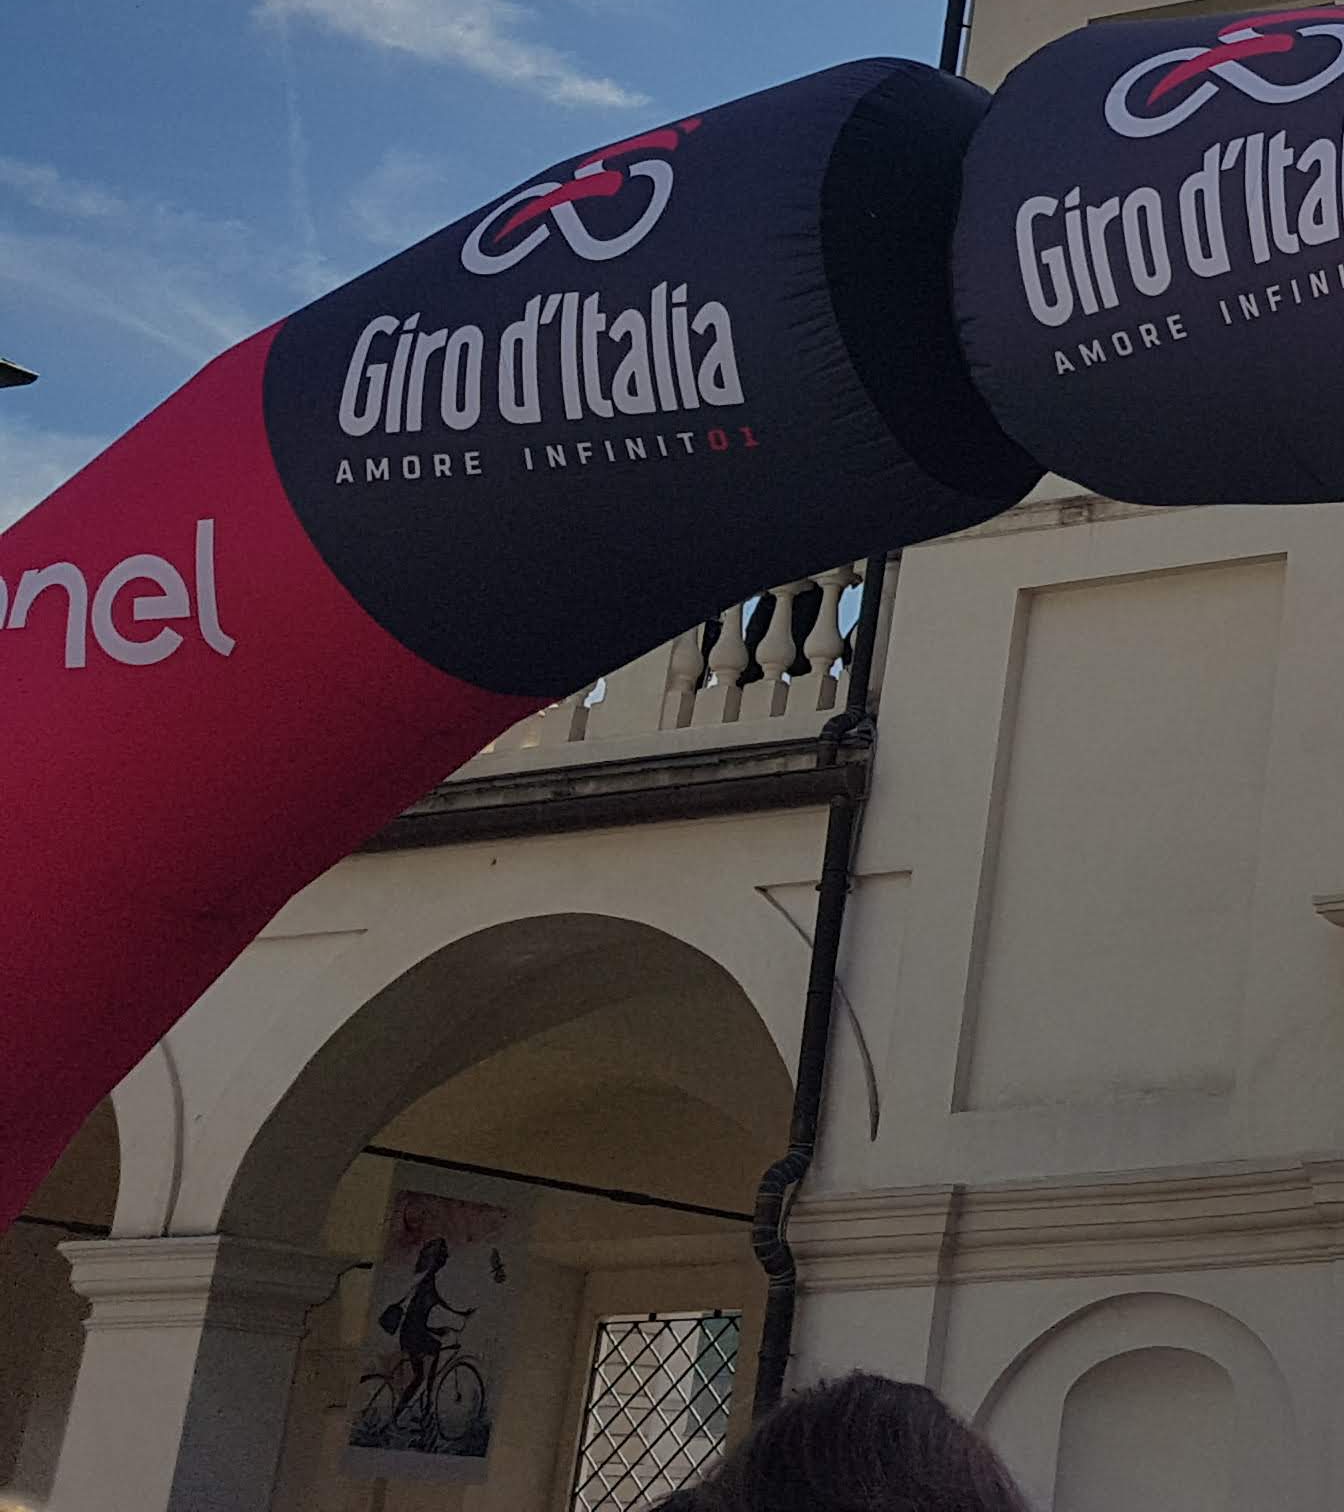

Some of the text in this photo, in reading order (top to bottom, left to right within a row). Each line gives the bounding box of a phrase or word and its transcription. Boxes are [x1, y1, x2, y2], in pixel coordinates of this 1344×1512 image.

[1014, 184, 1172, 328] Giro
[337, 279, 746, 438] Giro d'Italia
[1053, 312, 1188, 376] AMORE
[334, 450, 483, 485] AMORE
[0, 518, 236, 669] nel
